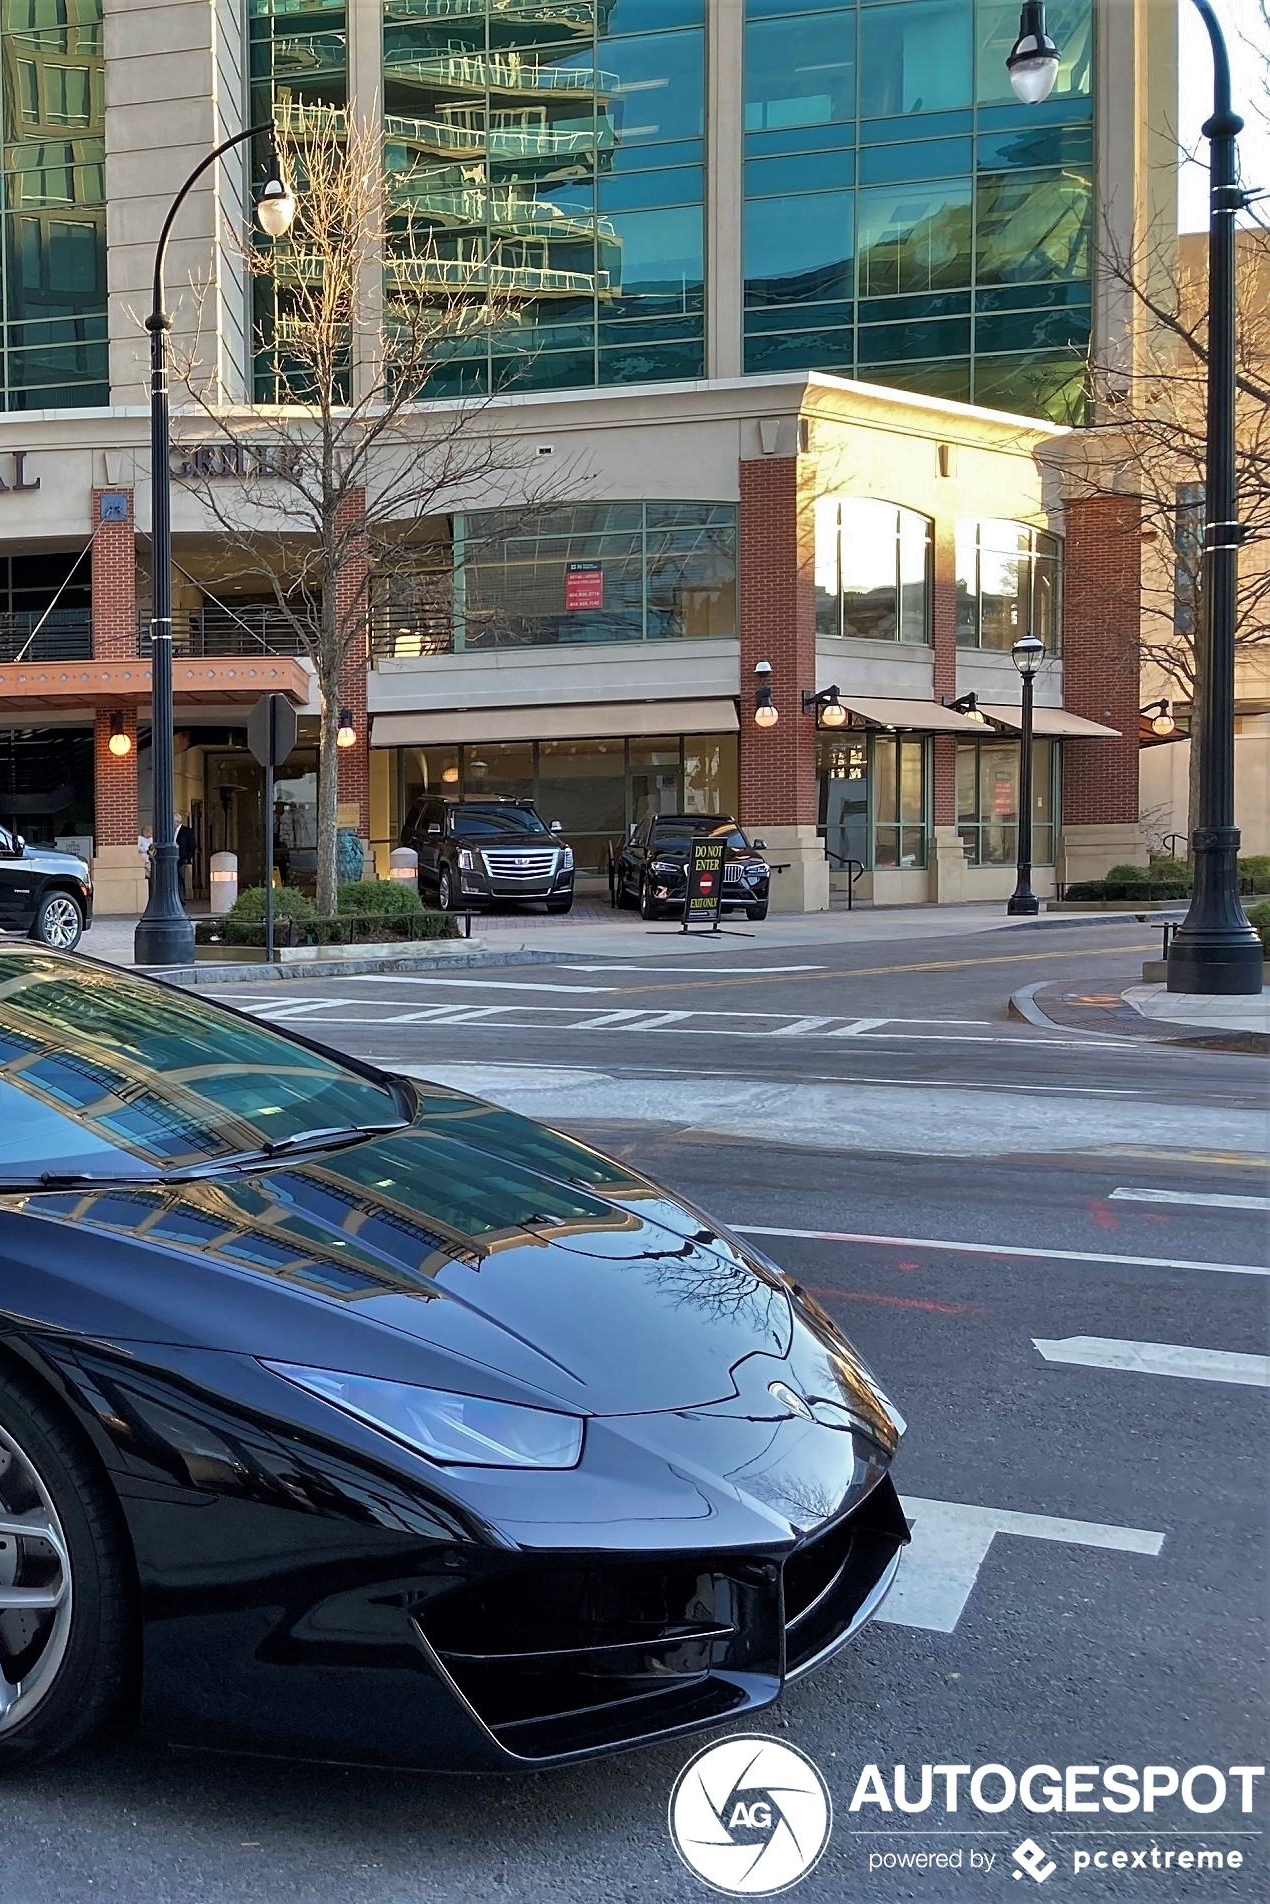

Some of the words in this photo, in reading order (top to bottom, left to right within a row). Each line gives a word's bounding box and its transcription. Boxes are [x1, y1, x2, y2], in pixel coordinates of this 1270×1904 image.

[694, 846, 706, 858] DO
[708, 846, 724, 858] NOT
[696, 859, 719, 870] ENTER
[690, 898, 702, 908] EXIT
[703, 898, 718, 908] ONLY
